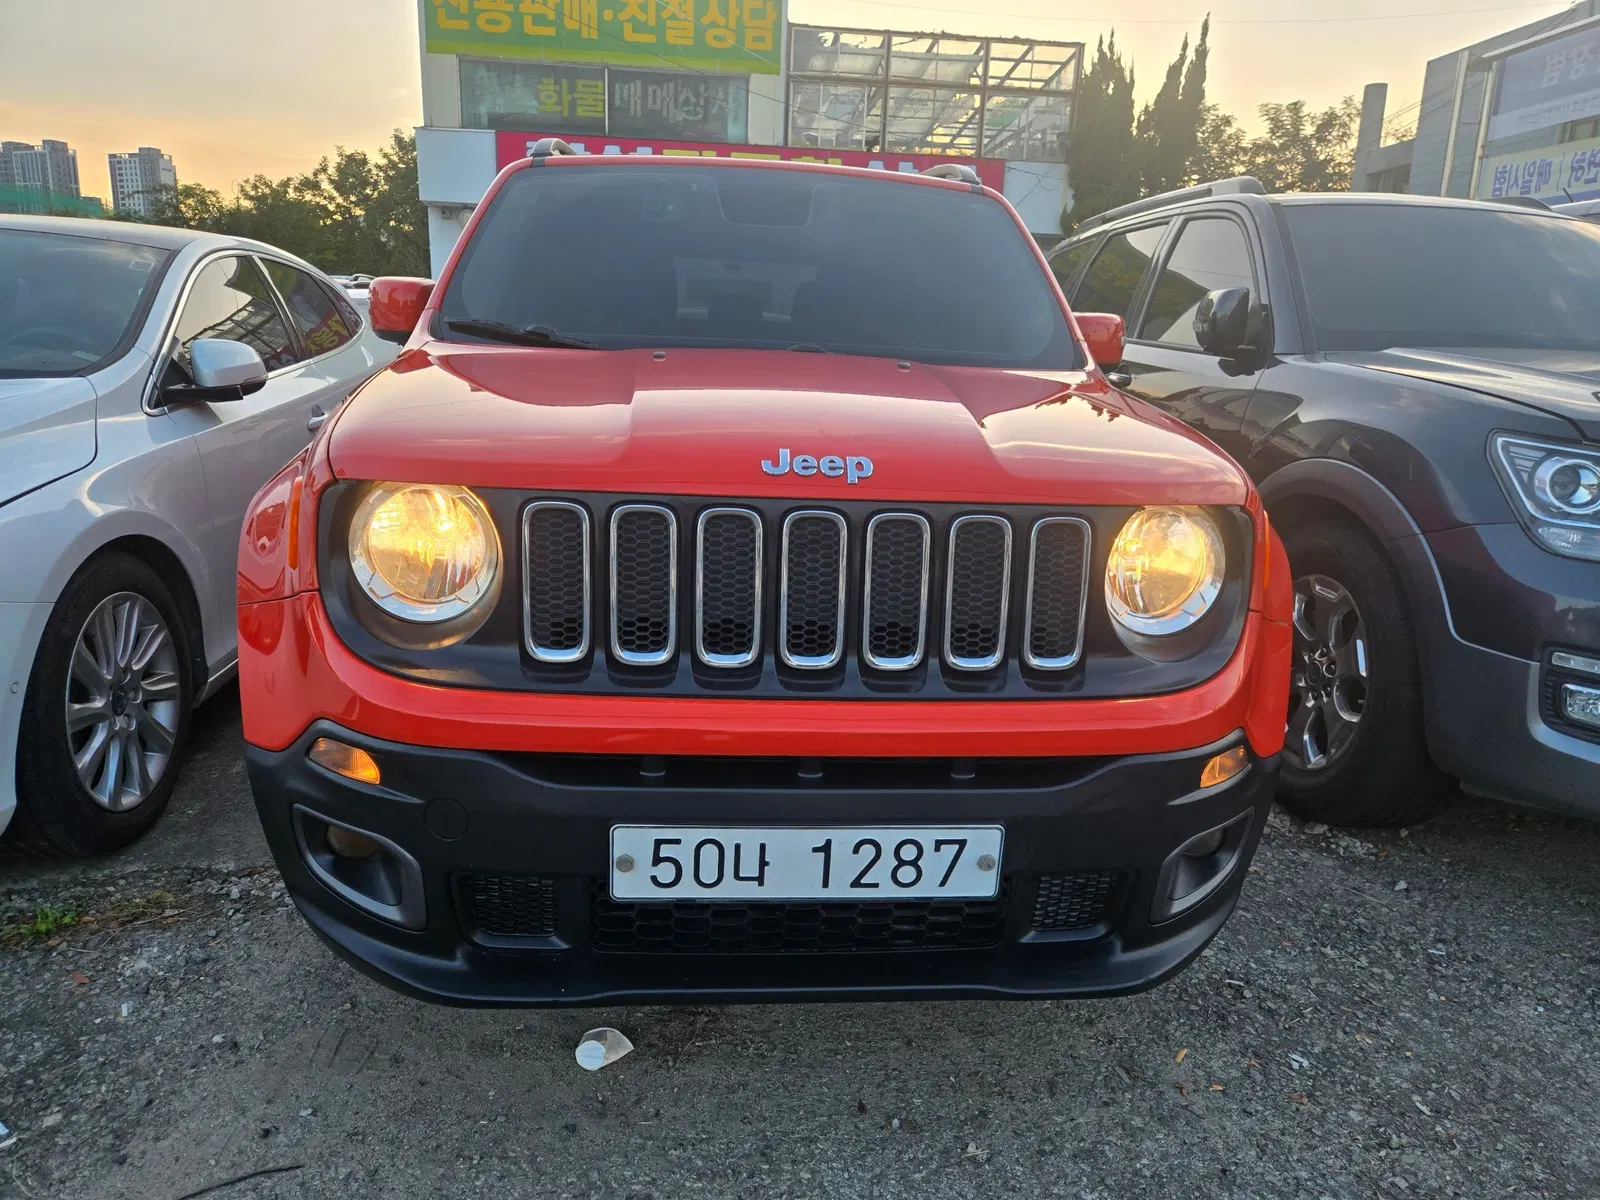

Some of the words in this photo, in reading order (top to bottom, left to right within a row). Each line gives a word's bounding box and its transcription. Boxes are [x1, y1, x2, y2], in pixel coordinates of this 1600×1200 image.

[536, 77, 605, 117] 화물
[761, 448, 874, 485] Jeep
[649, 837, 770, 889] 50나
[811, 837, 968, 889] 1287
